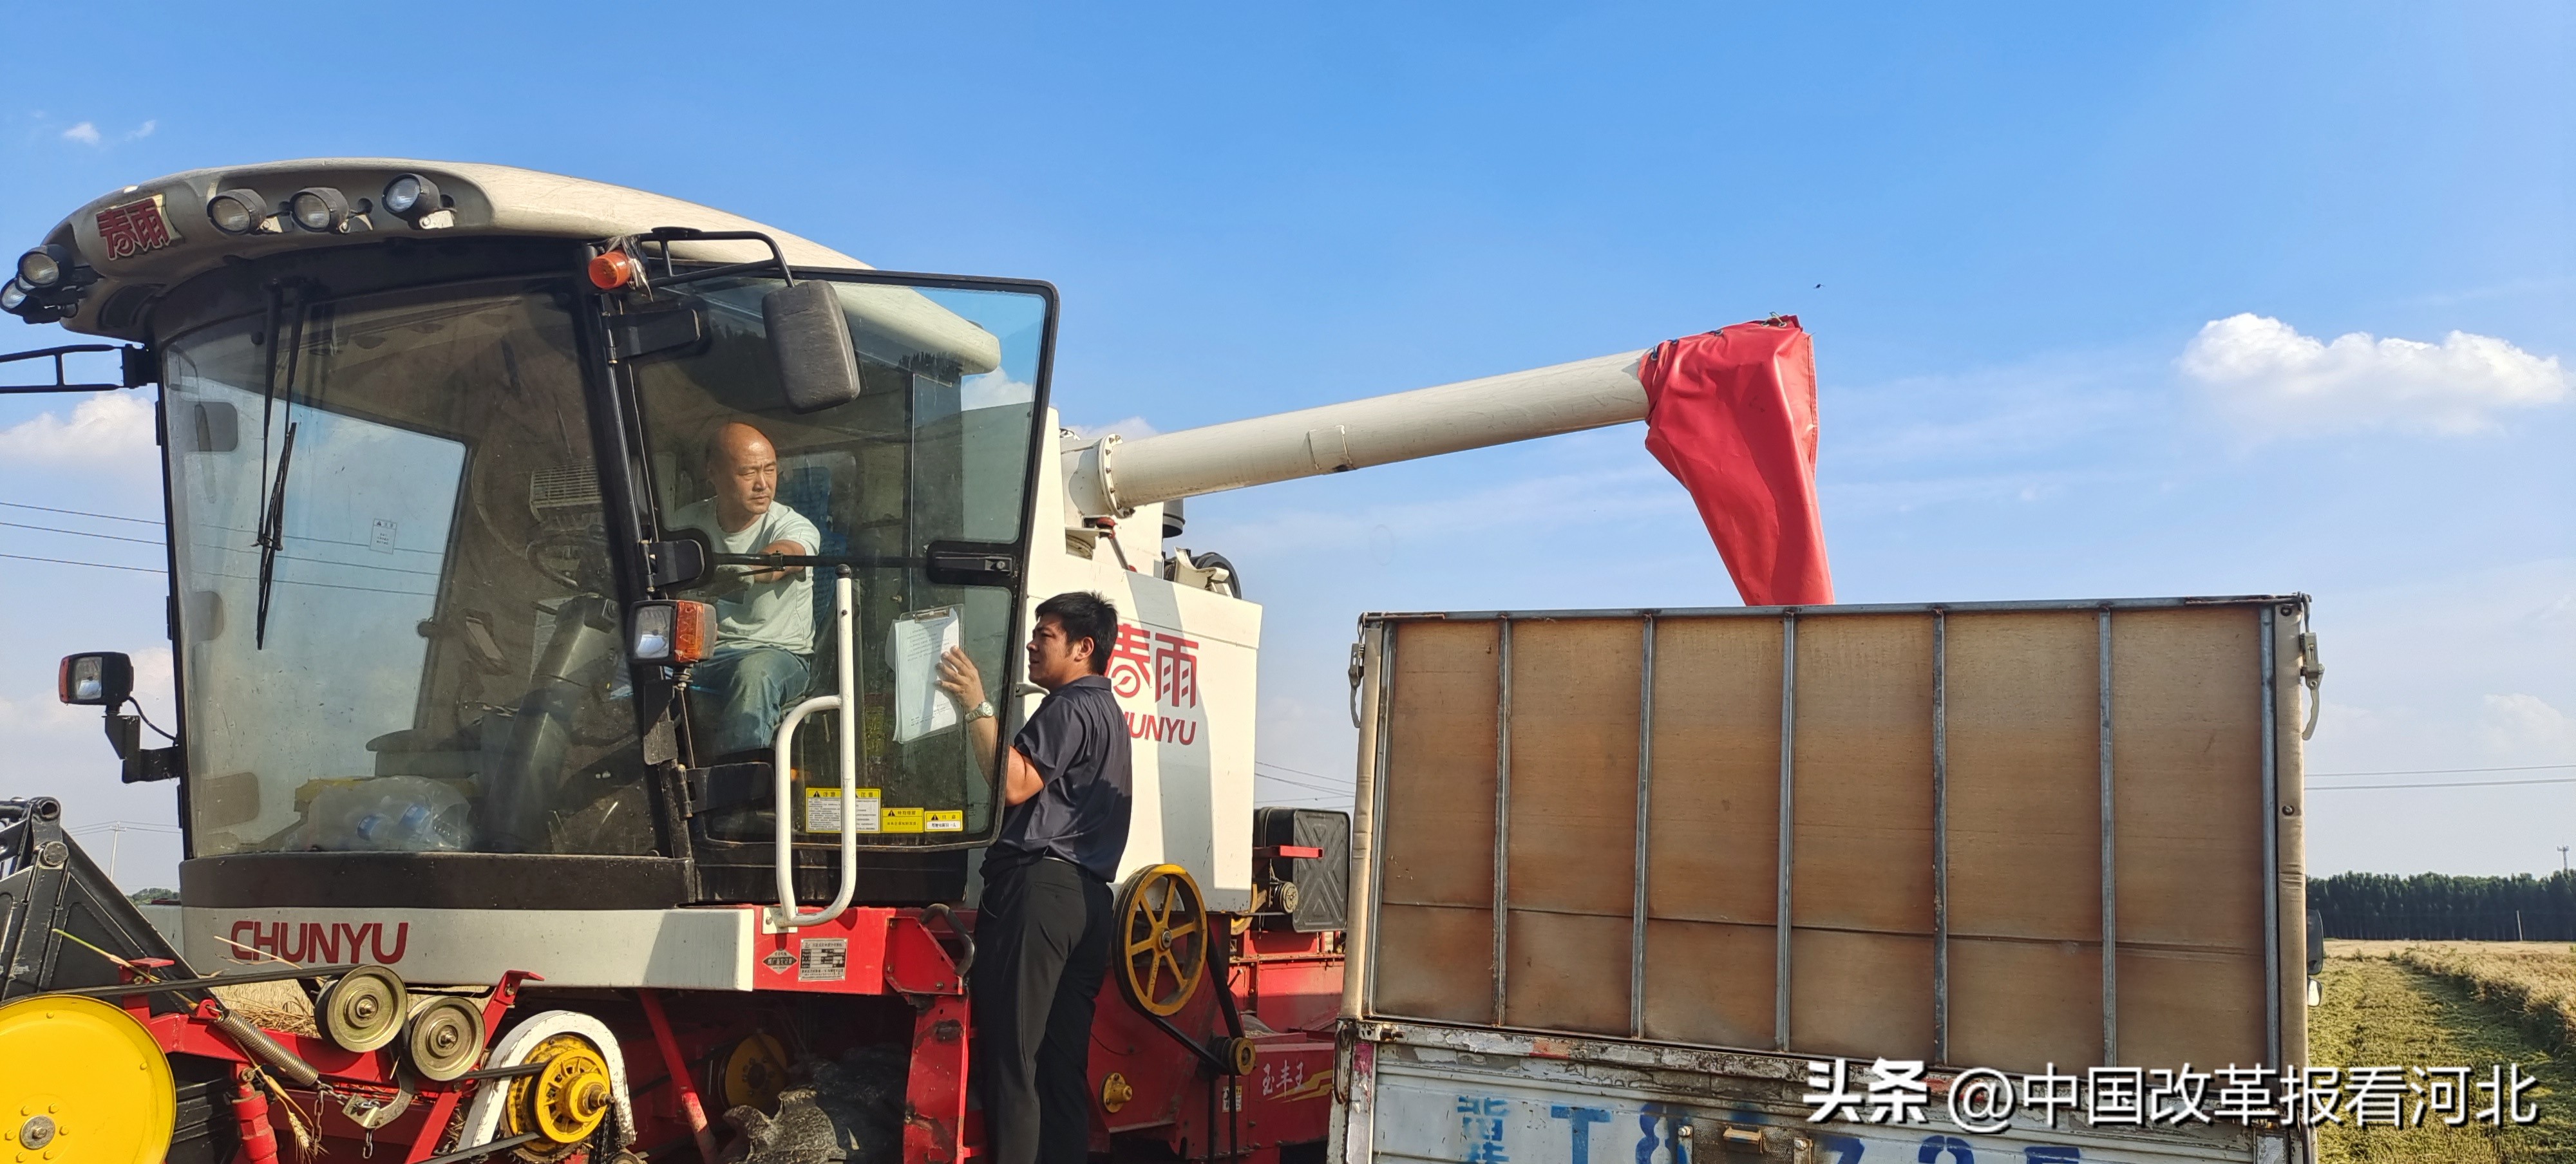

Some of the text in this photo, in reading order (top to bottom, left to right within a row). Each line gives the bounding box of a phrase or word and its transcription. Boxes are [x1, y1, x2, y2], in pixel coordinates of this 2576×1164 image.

[95, 197, 171, 259] 春雨
[1104, 623, 1199, 709] 春雨
[1124, 711, 1197, 746] UNYU
[231, 920, 409, 964] CHUNYU
